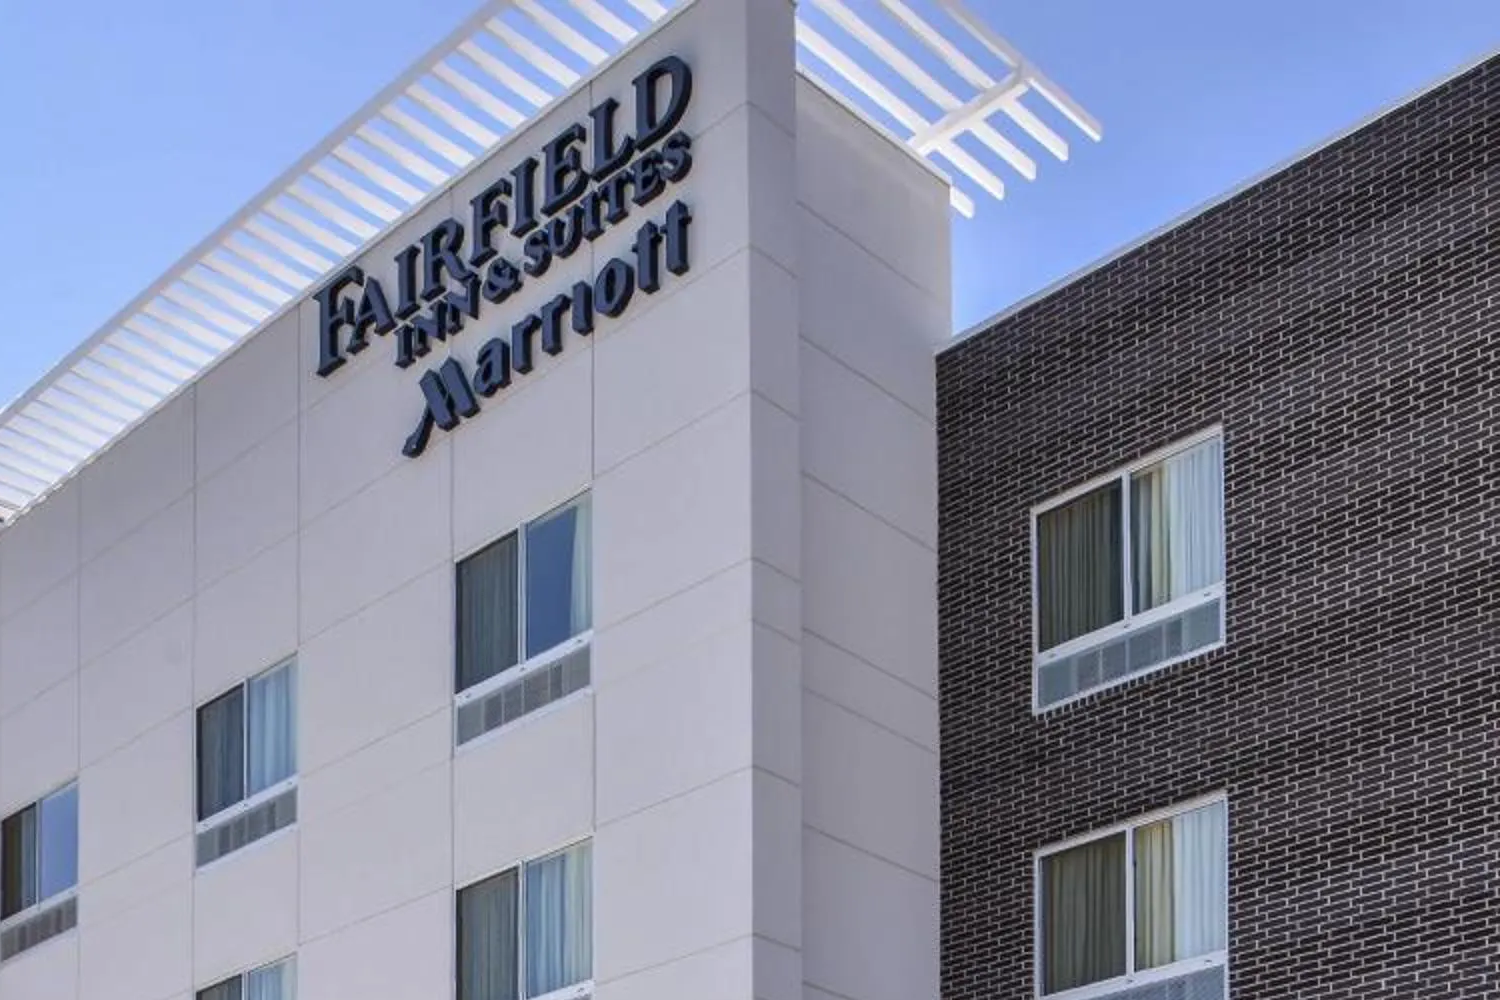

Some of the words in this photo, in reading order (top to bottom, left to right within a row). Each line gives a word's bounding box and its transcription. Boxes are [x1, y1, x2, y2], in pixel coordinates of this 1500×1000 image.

[312, 55, 693, 378] FAIRFIELD
[394, 273, 481, 369] INN
[482, 256, 524, 304] &
[523, 130, 693, 279] SUITES
[402, 199, 694, 459] Marriott
